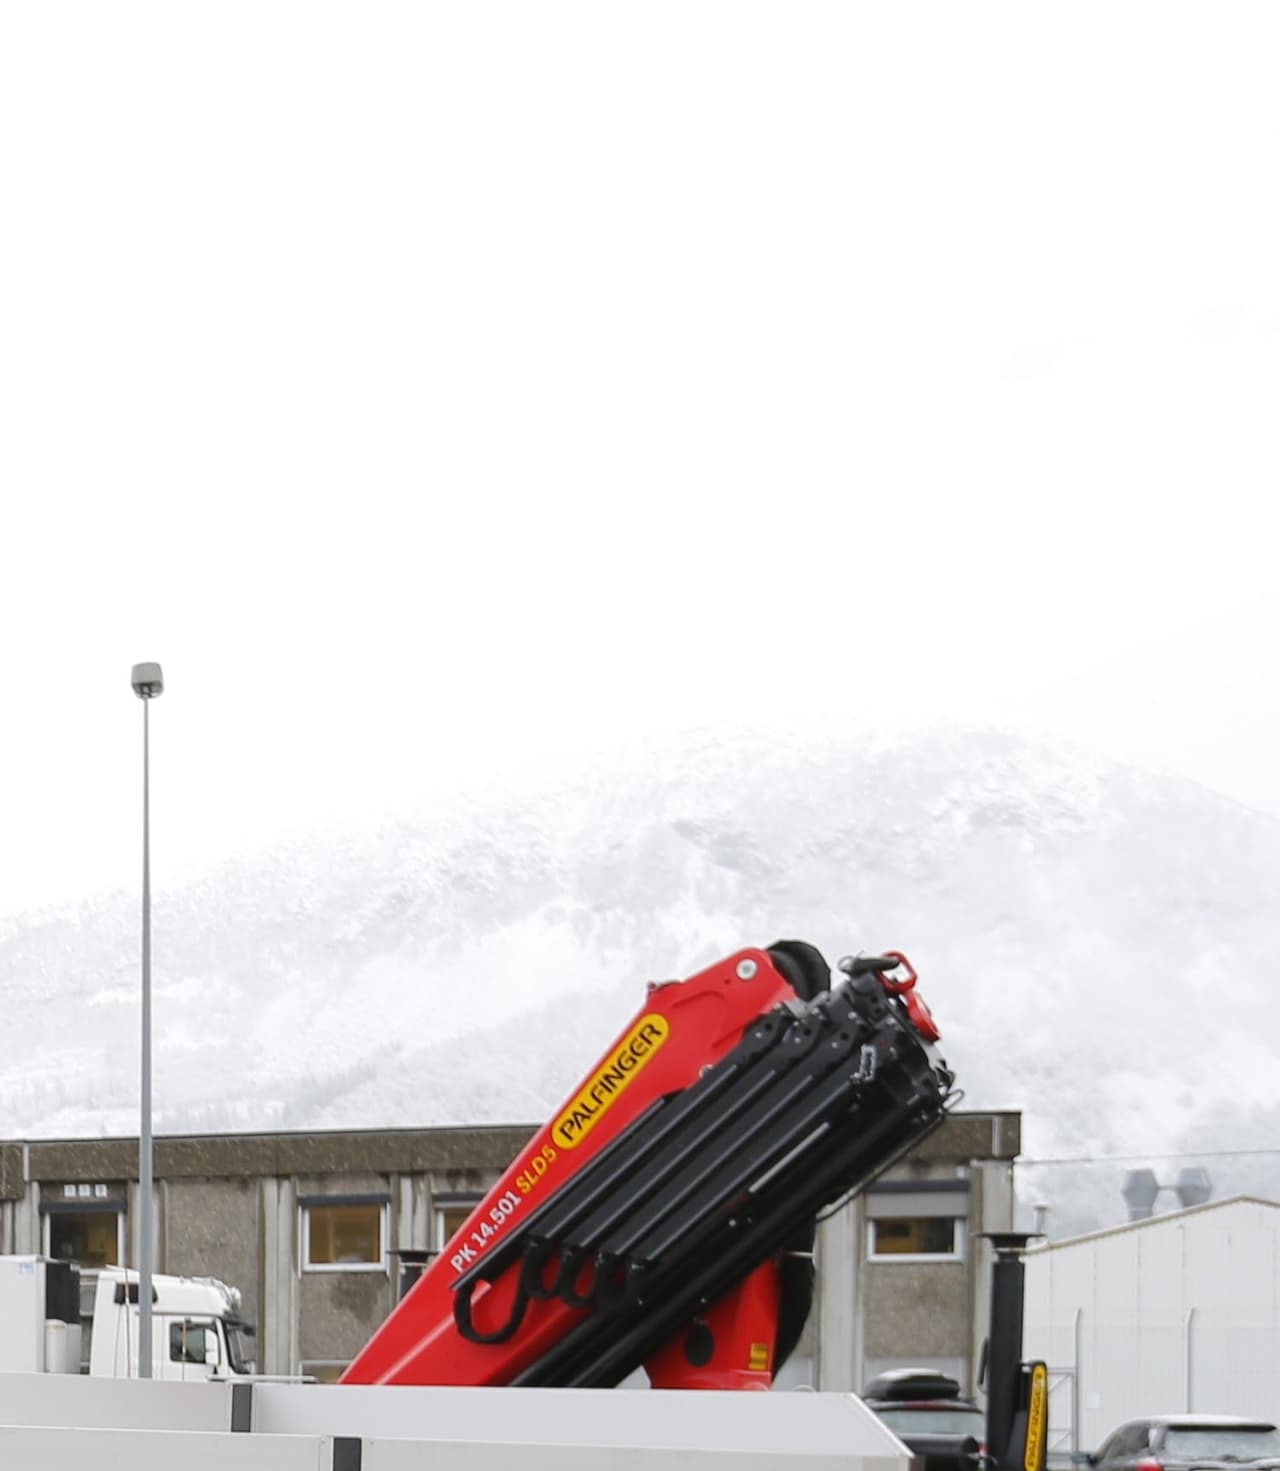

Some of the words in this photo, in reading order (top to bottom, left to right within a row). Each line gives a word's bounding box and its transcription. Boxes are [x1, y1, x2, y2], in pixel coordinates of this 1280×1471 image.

[559, 1022, 662, 1141] PALFINGER
[450, 1243, 477, 1274] PK
[471, 1190, 522, 1247] 14.501
[515, 1144, 557, 1194] SLD5
